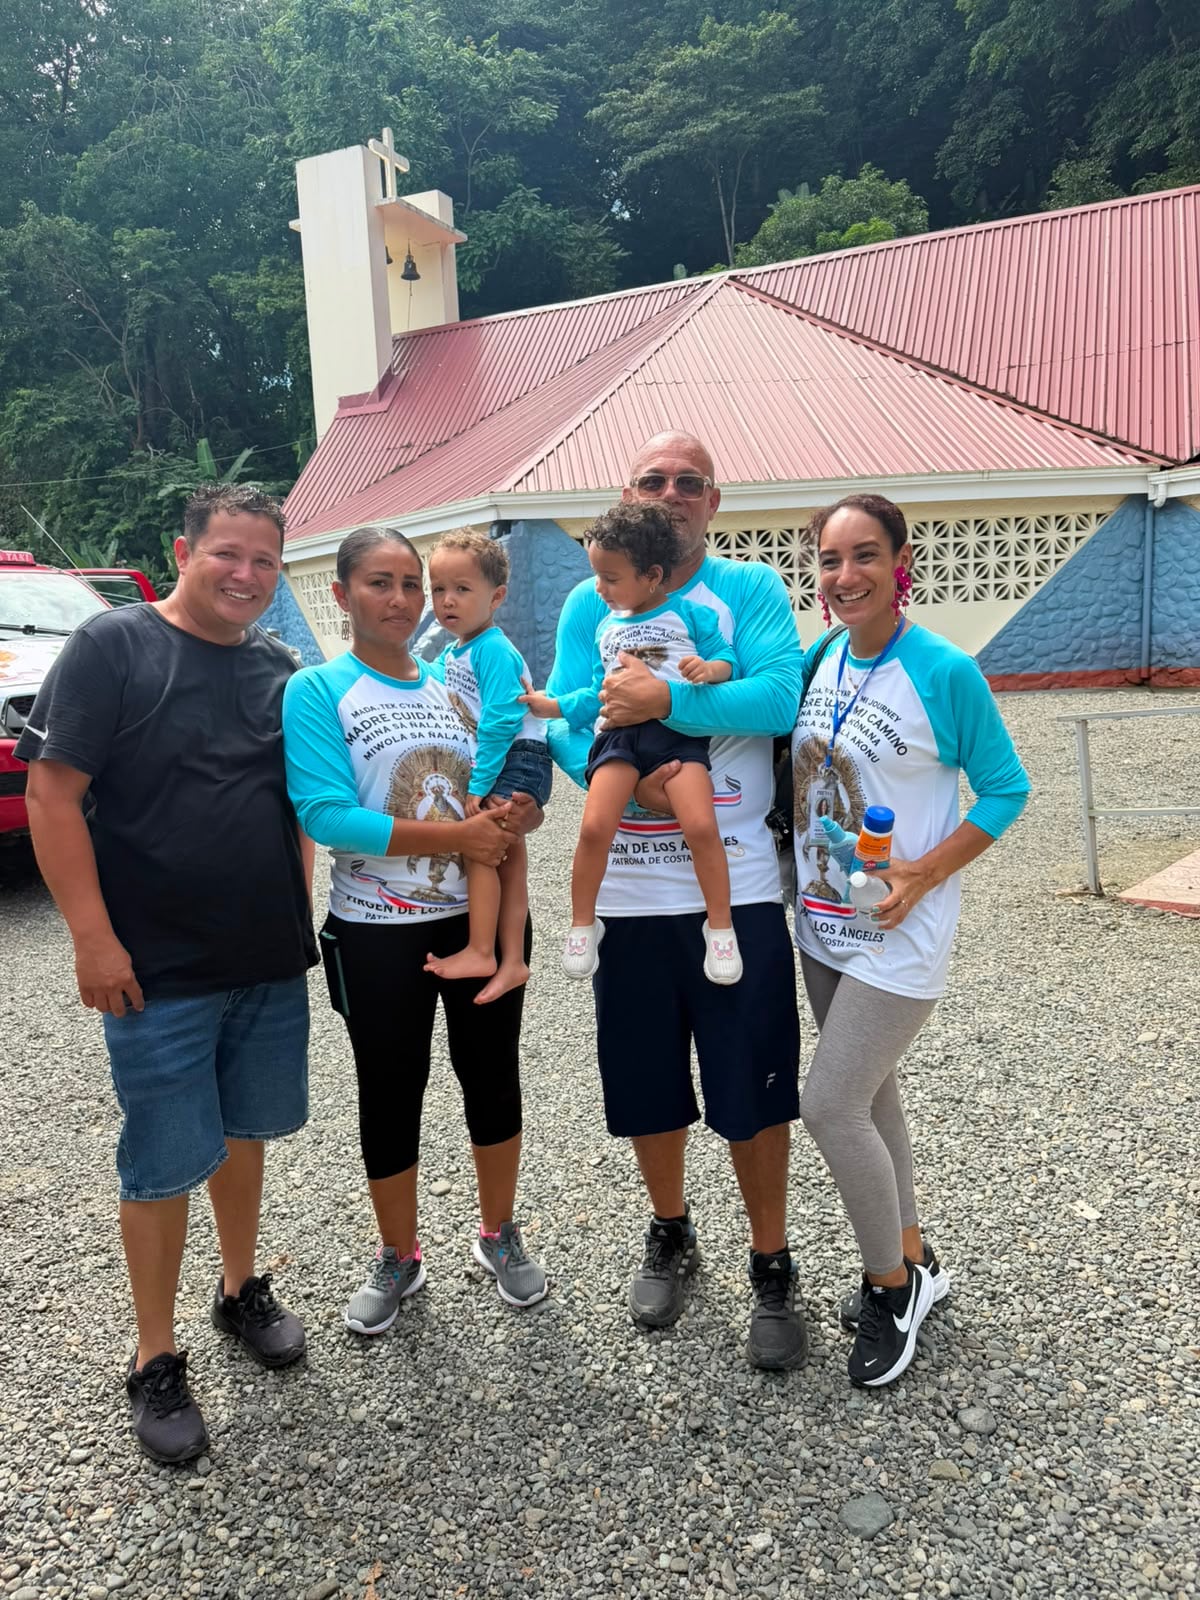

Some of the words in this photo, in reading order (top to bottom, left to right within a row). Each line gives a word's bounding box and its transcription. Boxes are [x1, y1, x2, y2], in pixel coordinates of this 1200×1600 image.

[7, 553, 29, 562] TAXI
[399, 702, 424, 710] CYAR
[860, 695, 869, 704] MI
[868, 698, 902, 723] JOURNEY
[345, 713, 391, 746] MADRE
[391, 711, 437, 721] CUIDA
[362, 725, 391, 745] MINA
[853, 704, 868, 718] MI
[867, 713, 908, 757] CAMINO
[363, 732, 408, 761] MIWOLA
[850, 735, 881, 763] AKONU
[632, 842, 650, 854] DE
[654, 841, 677, 853] LOS
[611, 855, 646, 865] PATRONA
[648, 855, 661, 864] DE
[663, 854, 693, 864] COSTA
[397, 906, 417, 915] DE
[421, 906, 446, 916] LOS
[814, 920, 836, 935] LOS
[820, 936, 845, 948] COSTA
